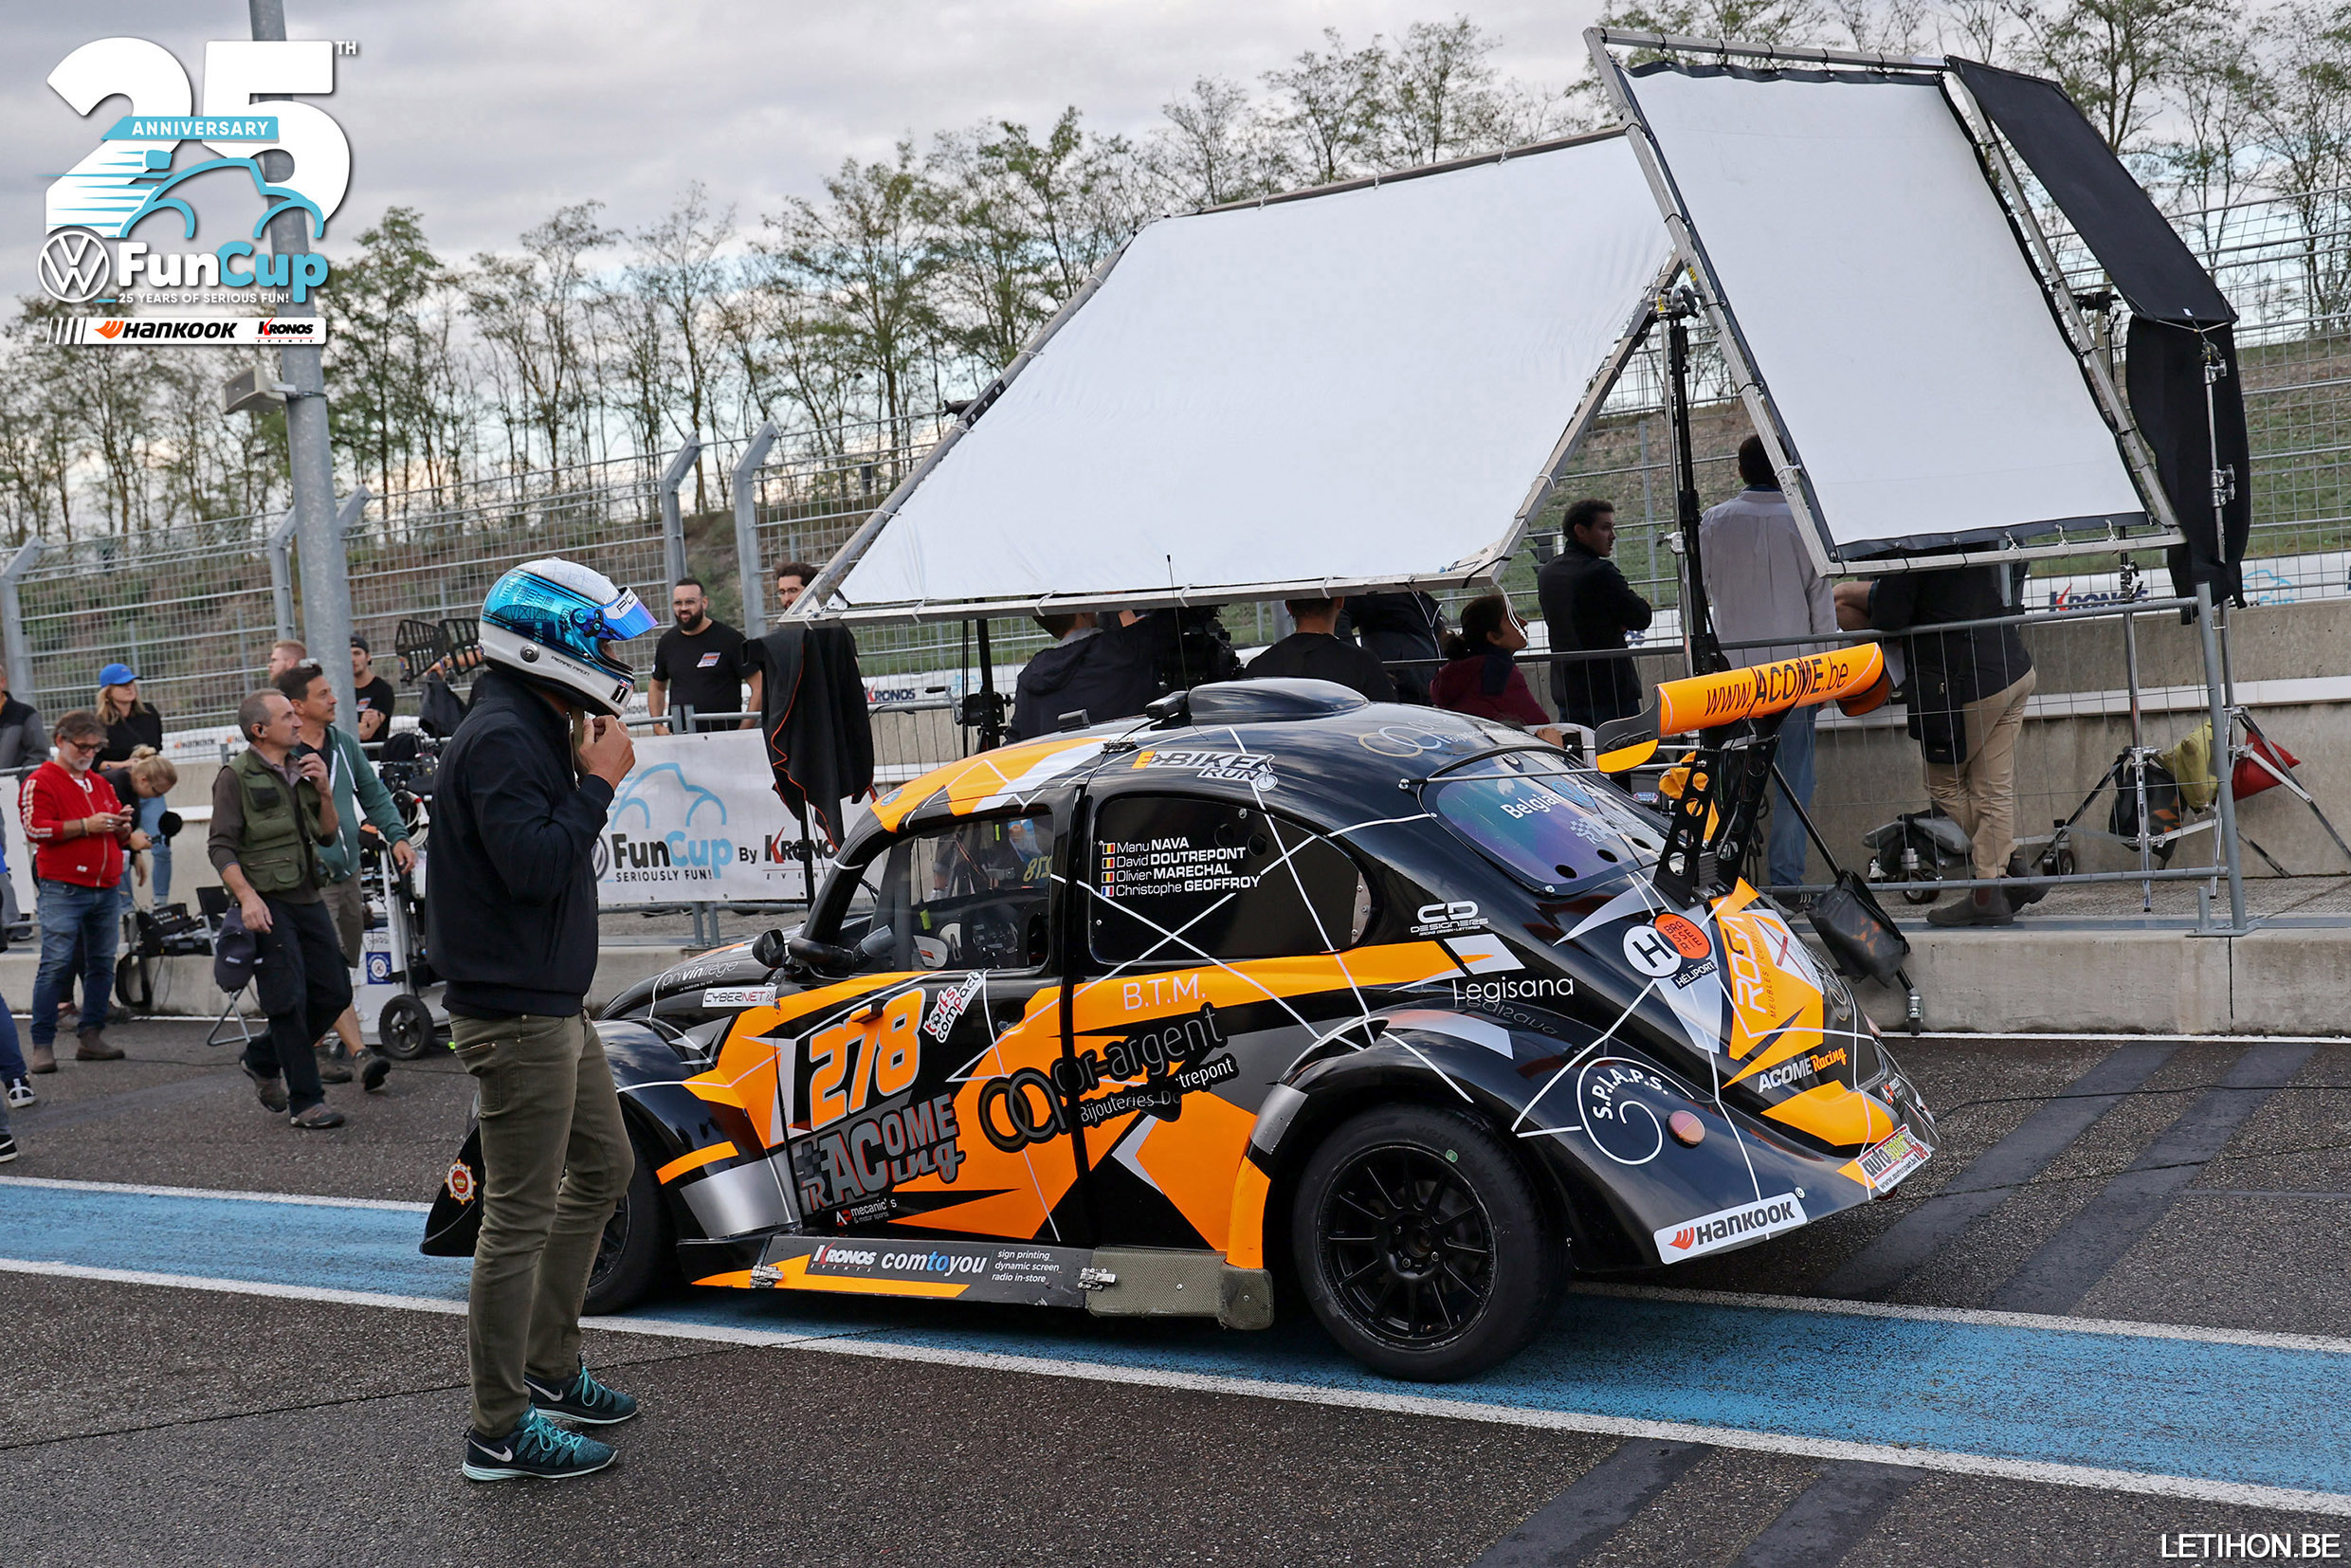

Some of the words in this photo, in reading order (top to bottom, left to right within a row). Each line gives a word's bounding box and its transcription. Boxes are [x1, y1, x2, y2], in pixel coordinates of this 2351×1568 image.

[614, 687, 626, 702] 1
[1201, 767, 1258, 781] RUN
[1501, 793, 1565, 819] Belgian
[611, 830, 733, 879] FunCup
[739, 847, 757, 865] By
[1116, 842, 1150, 853] Manu
[1151, 836, 1190, 851] NAVA
[1116, 854, 1149, 867] David
[1150, 847, 1247, 866] DOUTREPONT
[615, 869, 679, 883] SERIOUSLY
[684, 868, 712, 880] FUN!
[1116, 869, 1152, 883] Olivier
[1153, 863, 1232, 880] MARECHAL
[1116, 882, 1182, 897] Christophe
[1184, 875, 1261, 892] GEOFFROY
[1416, 901, 1479, 923] CD
[1410, 917, 1489, 934] DESIGNERS
[1122, 973, 1206, 1011] B.T.M.
[1451, 975, 1575, 1003] Legisana
[1762, 970, 1777, 1019] MEUBLES
[936, 974, 980, 1042] compact
[809, 987, 927, 1132] 278
[1054, 1007, 1223, 1091] or-argent
[1758, 1057, 1813, 1093] ACOME
[1810, 1047, 1848, 1073] Racing
[1080, 1091, 1155, 1123] Bijouteries
[1161, 1057, 1234, 1105] Dotrepont
[813, 1241, 877, 1266] KRONOS
[881, 1250, 988, 1277] comtoyou
[997, 1249, 1015, 1261] sign
[992, 1272, 1013, 1282] radio
[1014, 1273, 1047, 1283] in-store
[994, 1261, 1030, 1272] dynamic
